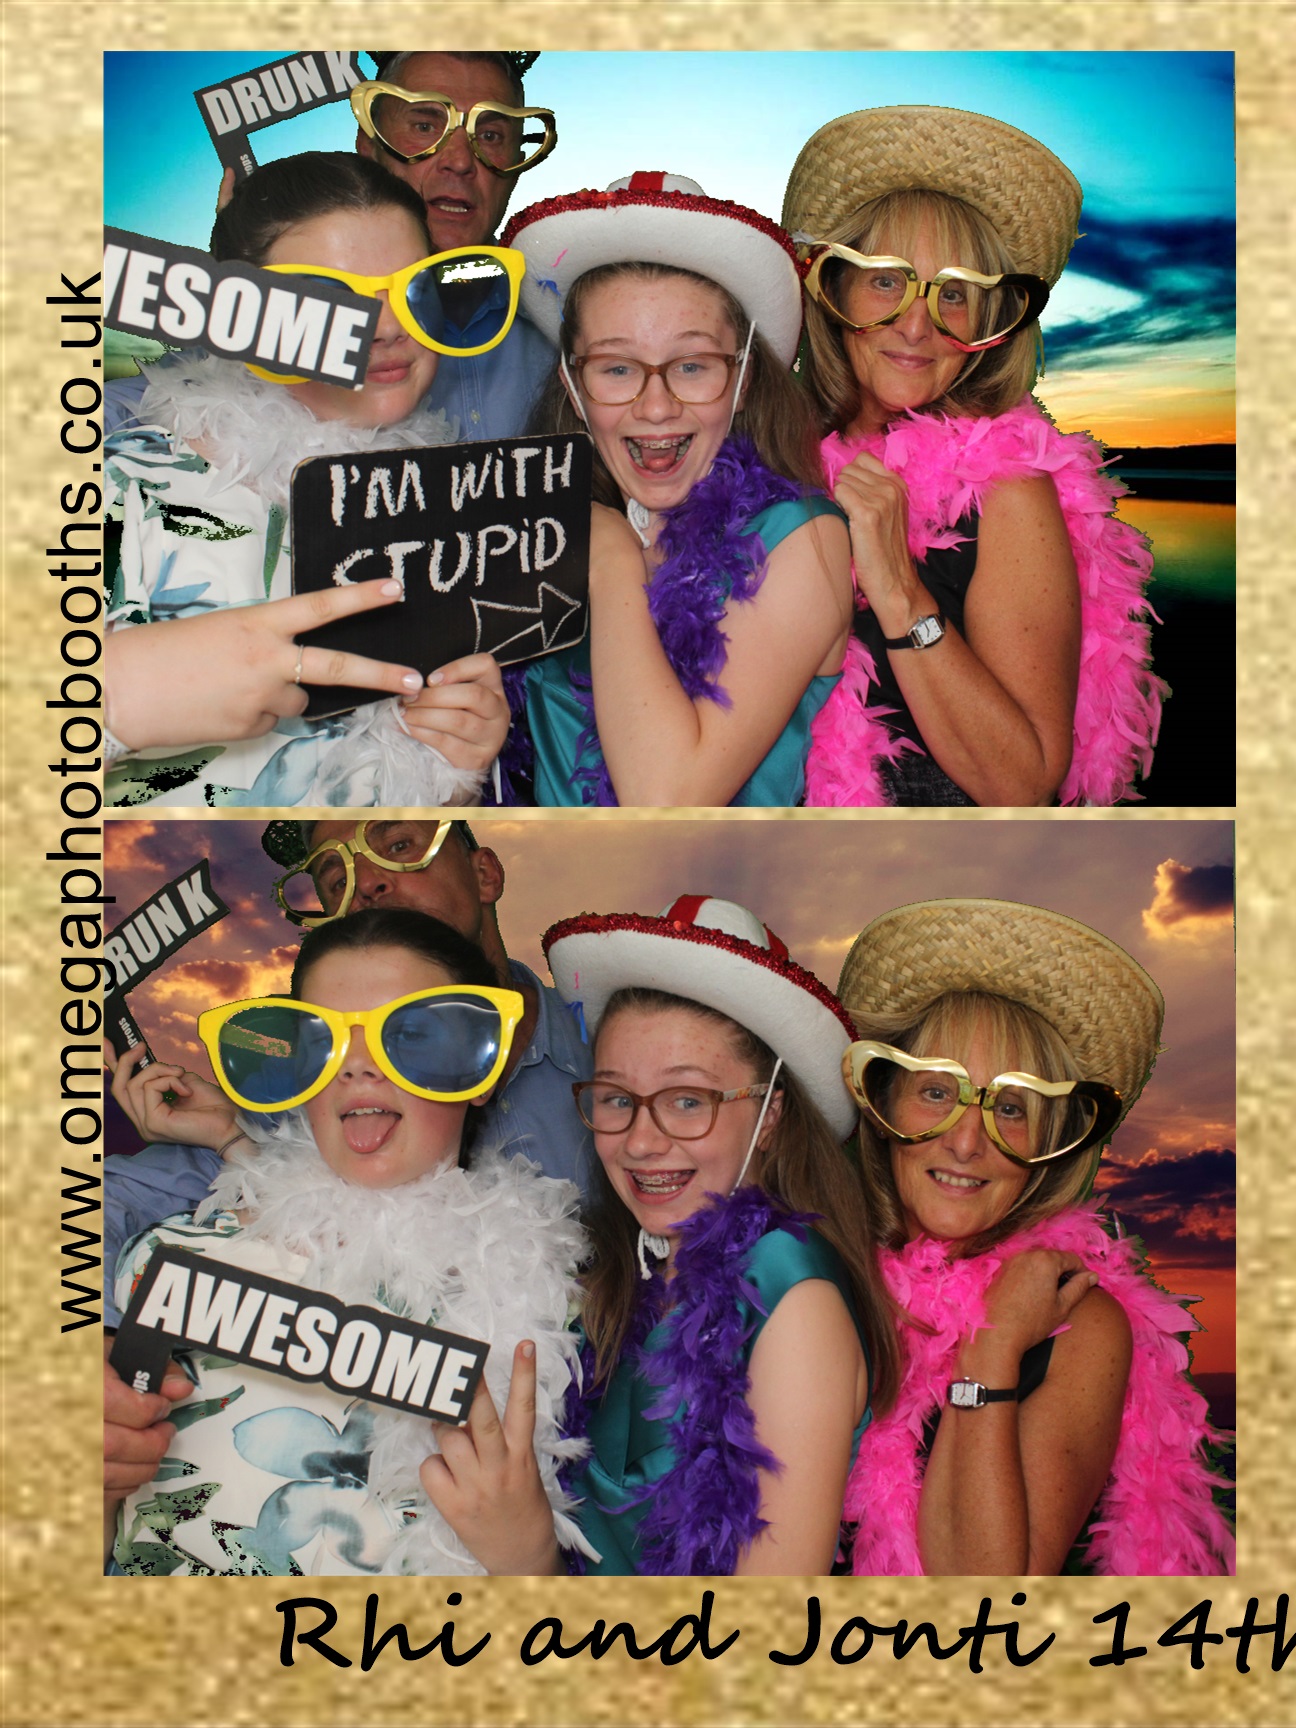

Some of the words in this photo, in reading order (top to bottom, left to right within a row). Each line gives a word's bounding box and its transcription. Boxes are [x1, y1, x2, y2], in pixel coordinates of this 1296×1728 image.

[103, 243, 369, 381] ESOME
[329, 458, 427, 528] I'M
[104, 869, 219, 1000] RUNK
[135, 1260, 477, 1418] AWESOME
